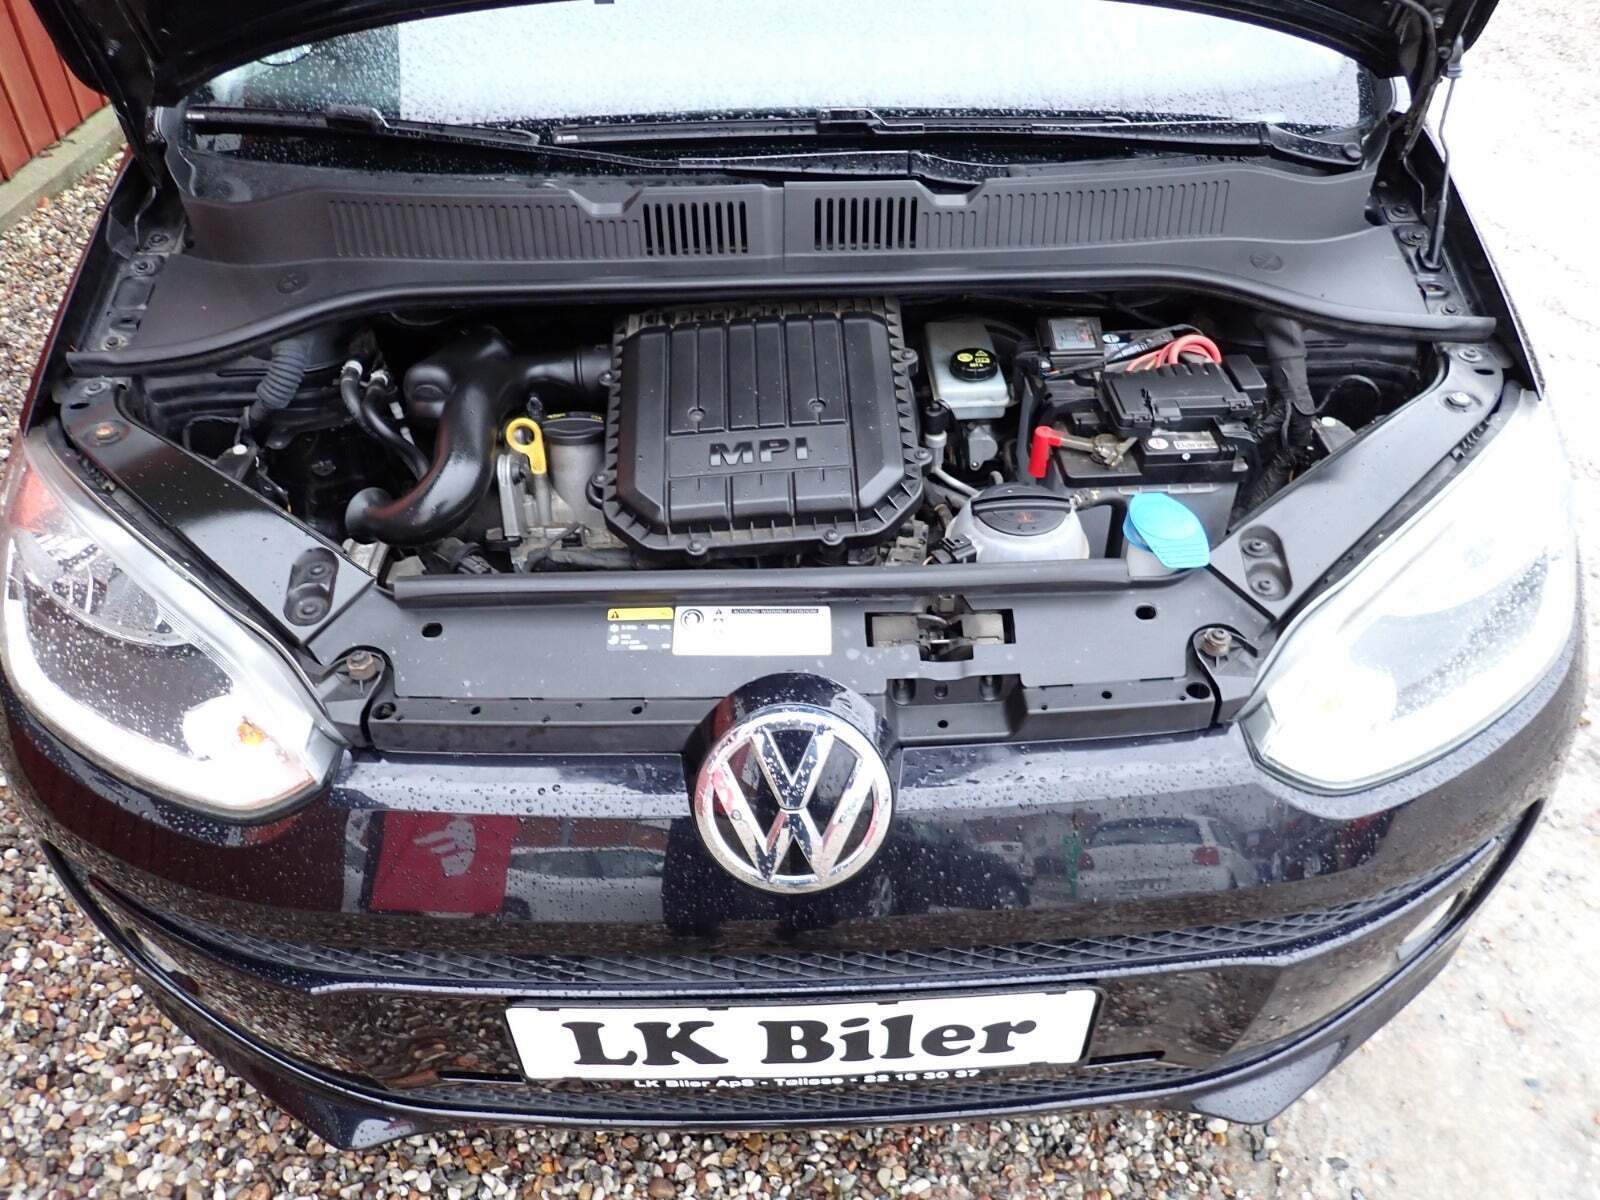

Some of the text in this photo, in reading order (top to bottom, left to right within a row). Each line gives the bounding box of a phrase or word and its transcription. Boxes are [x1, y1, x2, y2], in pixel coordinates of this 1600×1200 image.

[709, 437, 808, 466] MPI
[562, 1014, 1037, 1066] LK Biler
[633, 1079, 660, 1088] LK
[665, 1079, 711, 1088] Biler
[715, 1078, 755, 1089] ApS
